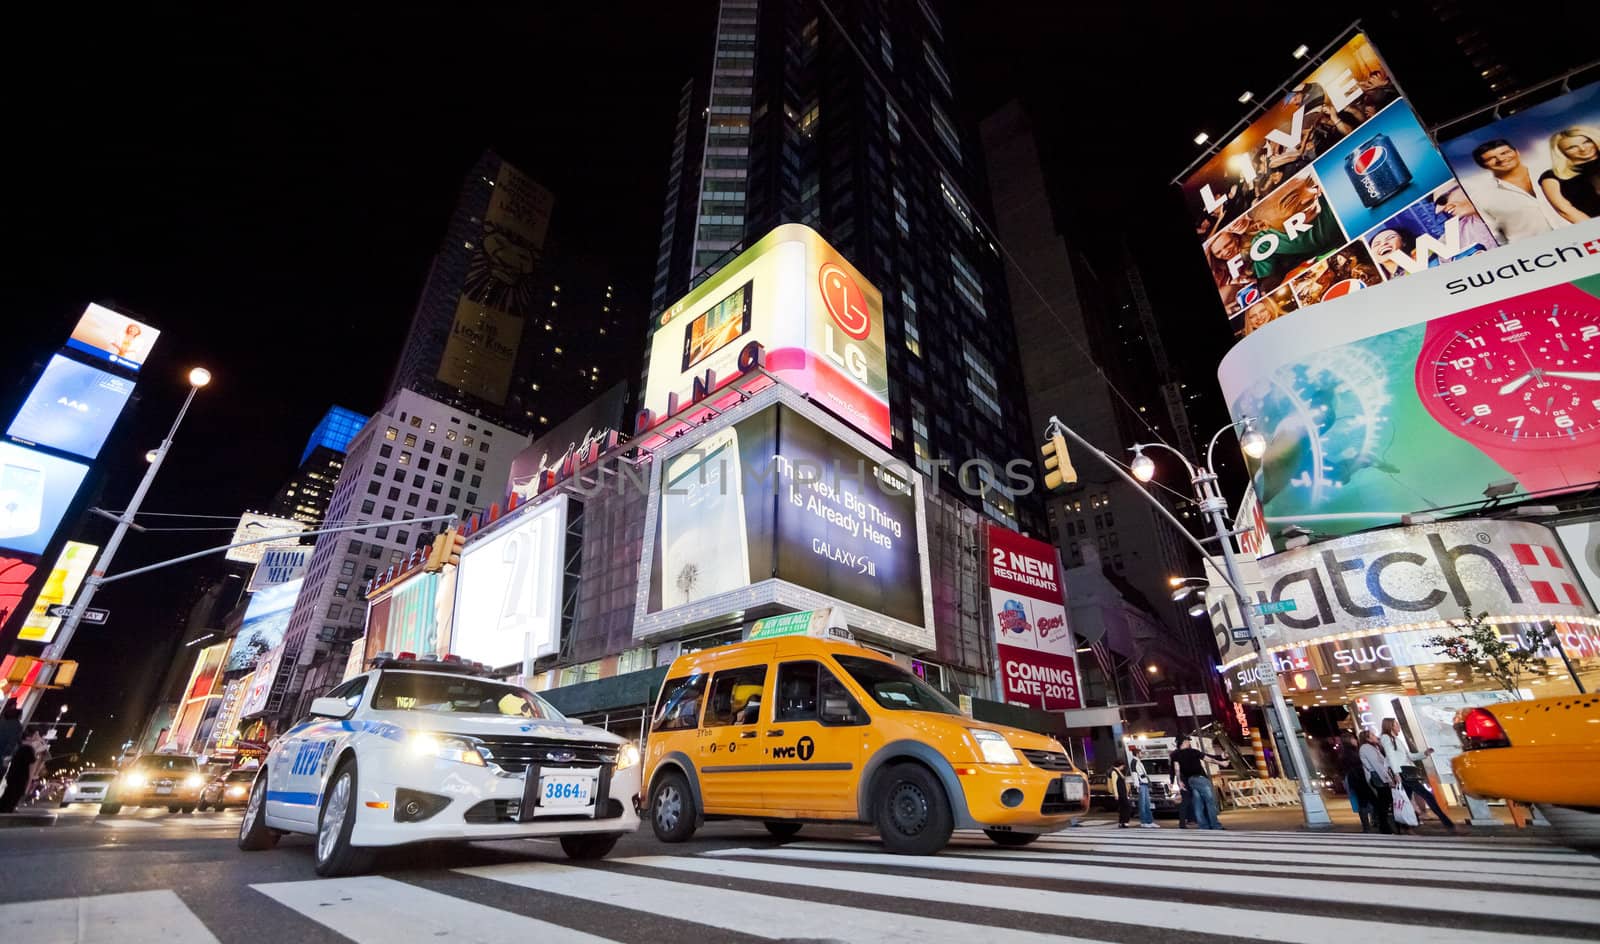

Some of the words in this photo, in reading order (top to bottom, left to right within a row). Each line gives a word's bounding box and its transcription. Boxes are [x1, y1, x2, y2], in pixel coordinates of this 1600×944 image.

[1200, 68, 1364, 214] LIVE
[1226, 212, 1313, 280] FOR
[1446, 246, 1584, 295] swatch
[1495, 319, 1523, 333] 12
[825, 325, 868, 384] LG
[1450, 356, 1475, 370] 10
[1472, 404, 1492, 417] 8
[1507, 415, 1525, 430] 7
[789, 484, 804, 508] Is
[807, 494, 861, 537] Already
[863, 523, 892, 549] Here
[808, 471, 841, 502] Next
[844, 490, 867, 519] Big
[868, 504, 902, 537] Thing
[265, 552, 304, 566] MAMMA
[812, 538, 857, 568] GALAXY
[993, 548, 1007, 567] 2
[1010, 551, 1055, 580] NEW
[993, 567, 1058, 592] RESTAURANTS
[1006, 660, 1074, 686] COMING
[1008, 677, 1042, 697] LATE
[1045, 683, 1076, 701] 2012
[773, 747, 796, 758] NYC
[545, 783, 580, 798] 3864
